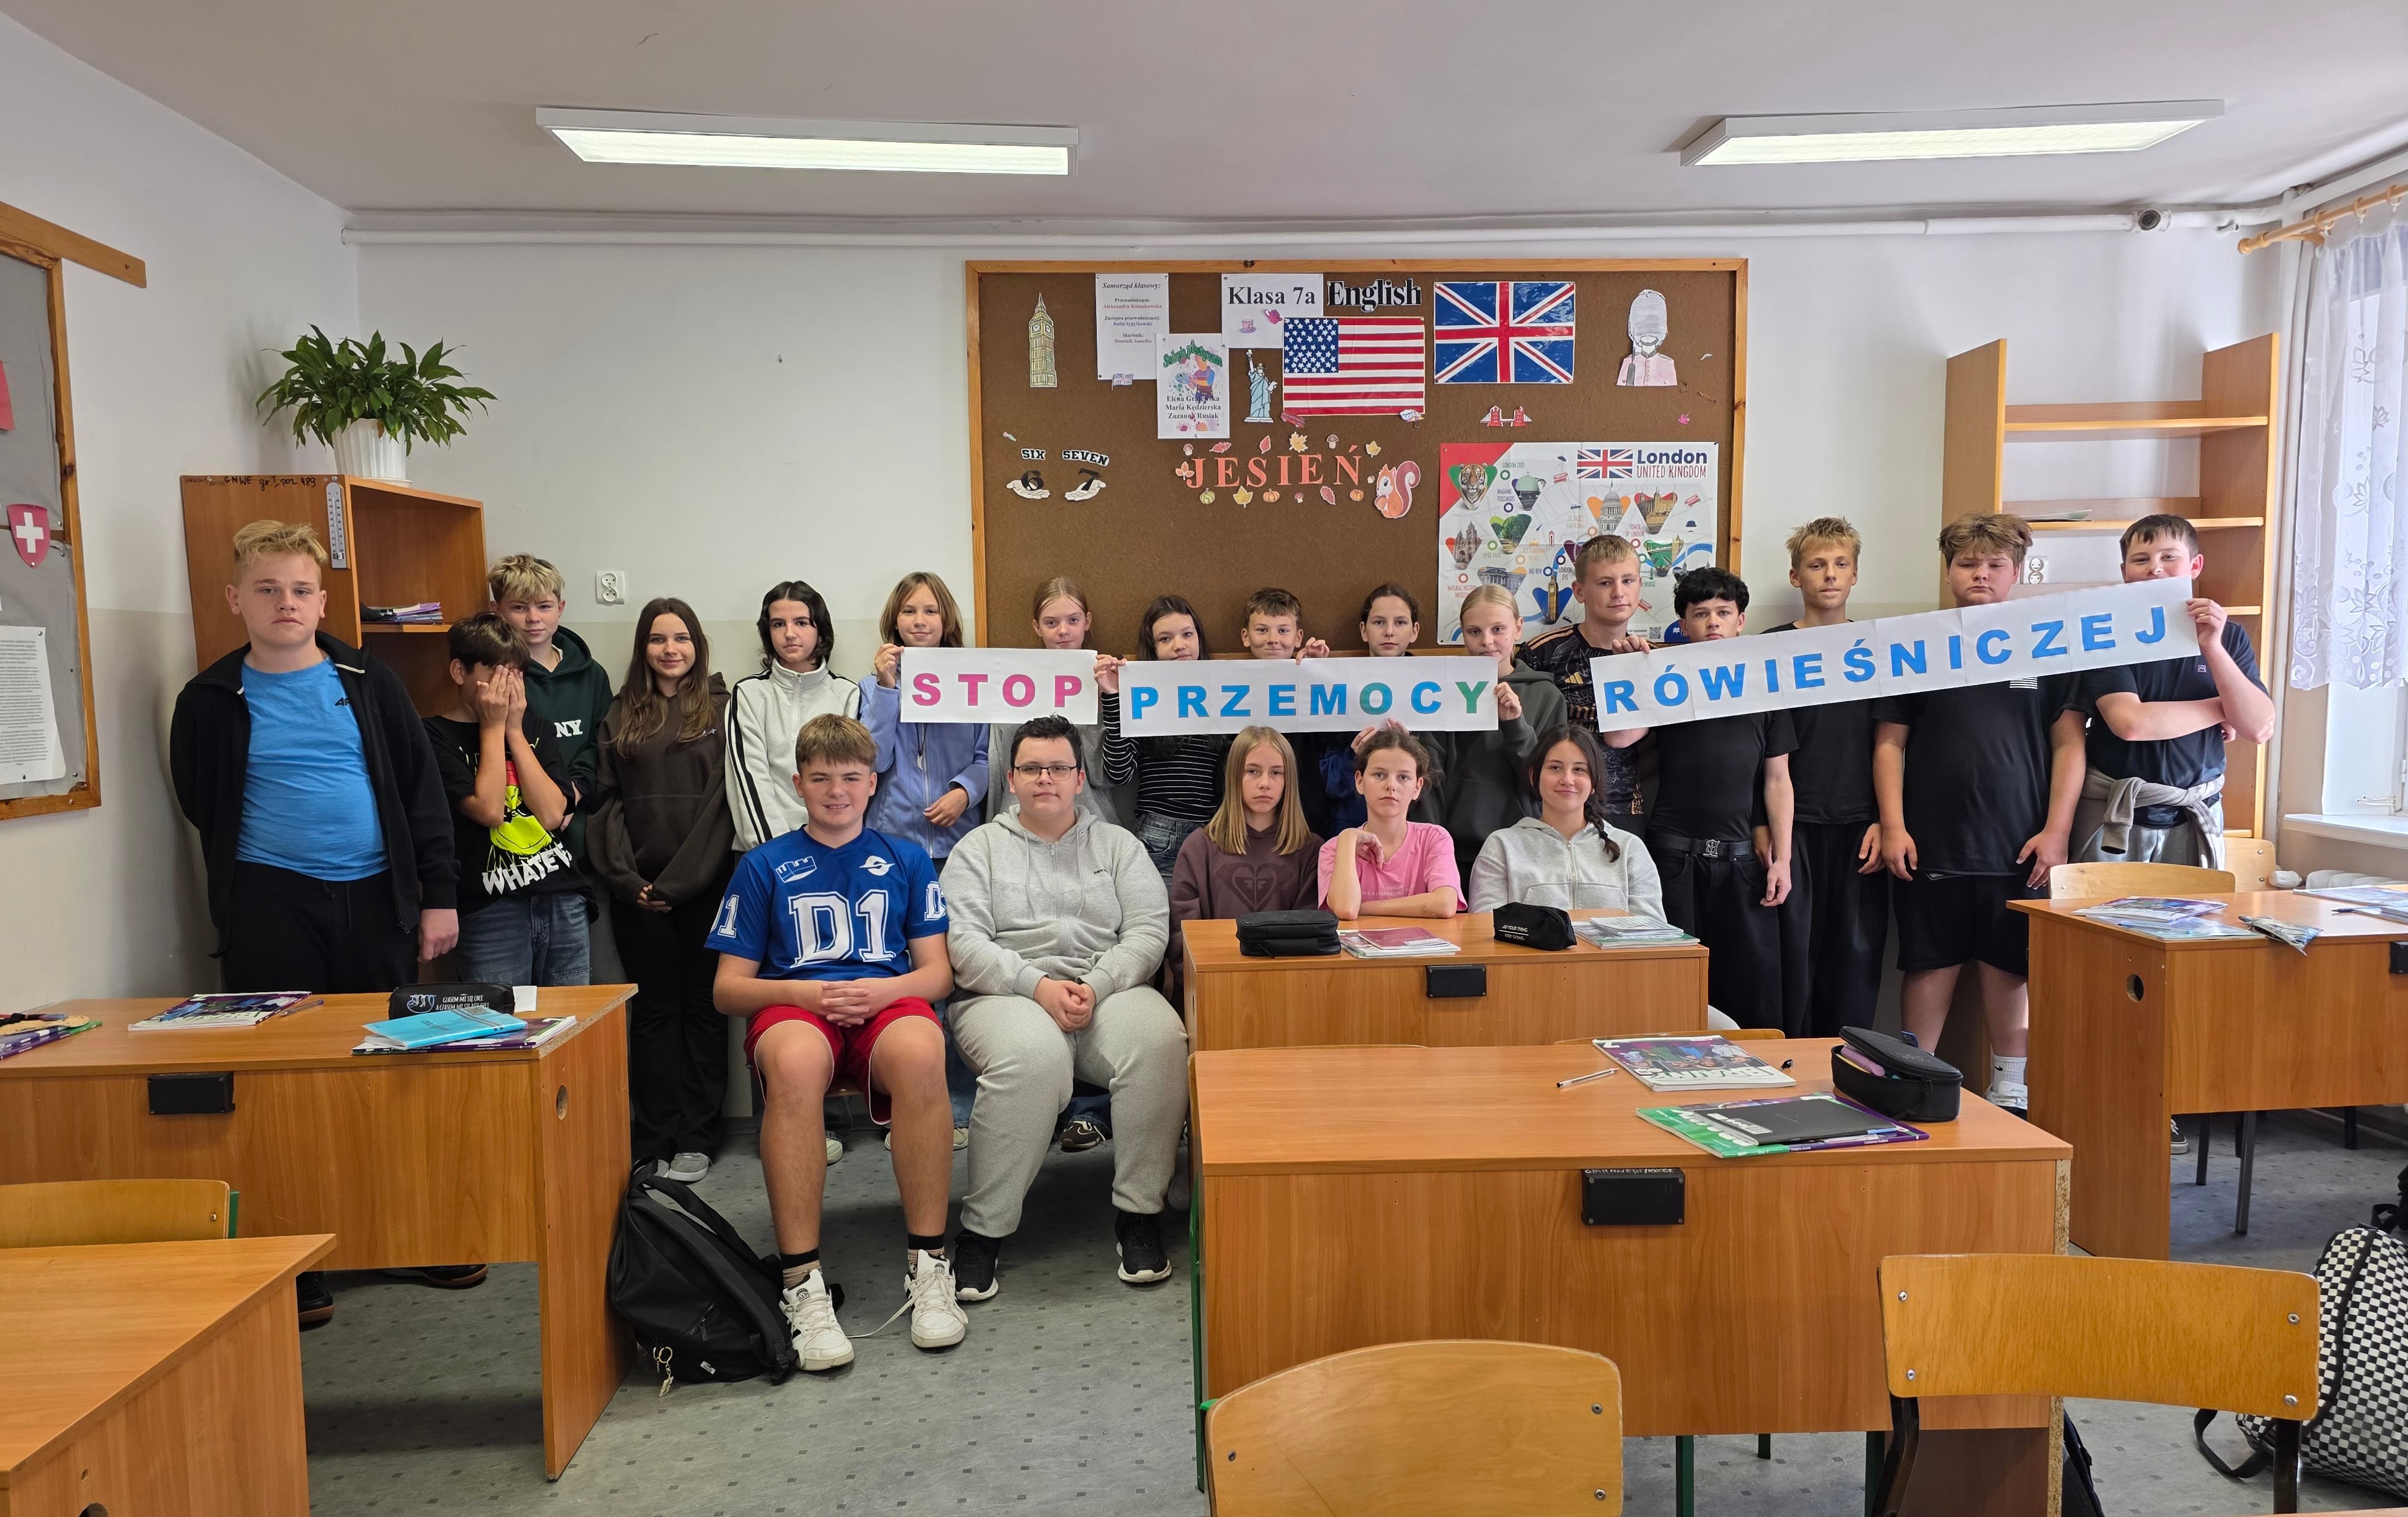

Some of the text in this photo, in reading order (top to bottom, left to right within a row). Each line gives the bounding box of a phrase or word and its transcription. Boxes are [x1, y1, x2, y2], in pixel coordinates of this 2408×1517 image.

[1227, 287, 1315, 305] Klasa 7a
[1328, 279, 1421, 311] English
[1022, 449, 1045, 459] SIX
[1063, 450, 1108, 465] SEVEN
[1186, 444, 1362, 489] JESIEŃ
[1637, 449, 1707, 465] London
[1637, 465, 1706, 479] UNITED KINGDOM
[1603, 606, 2167, 715] RÓWIEŚNICZEJ
[911, 672, 1082, 708] STOP
[1130, 680, 1491, 720] PRZEMOCY
[554, 719, 583, 738] NY
[787, 889, 897, 969] D1
